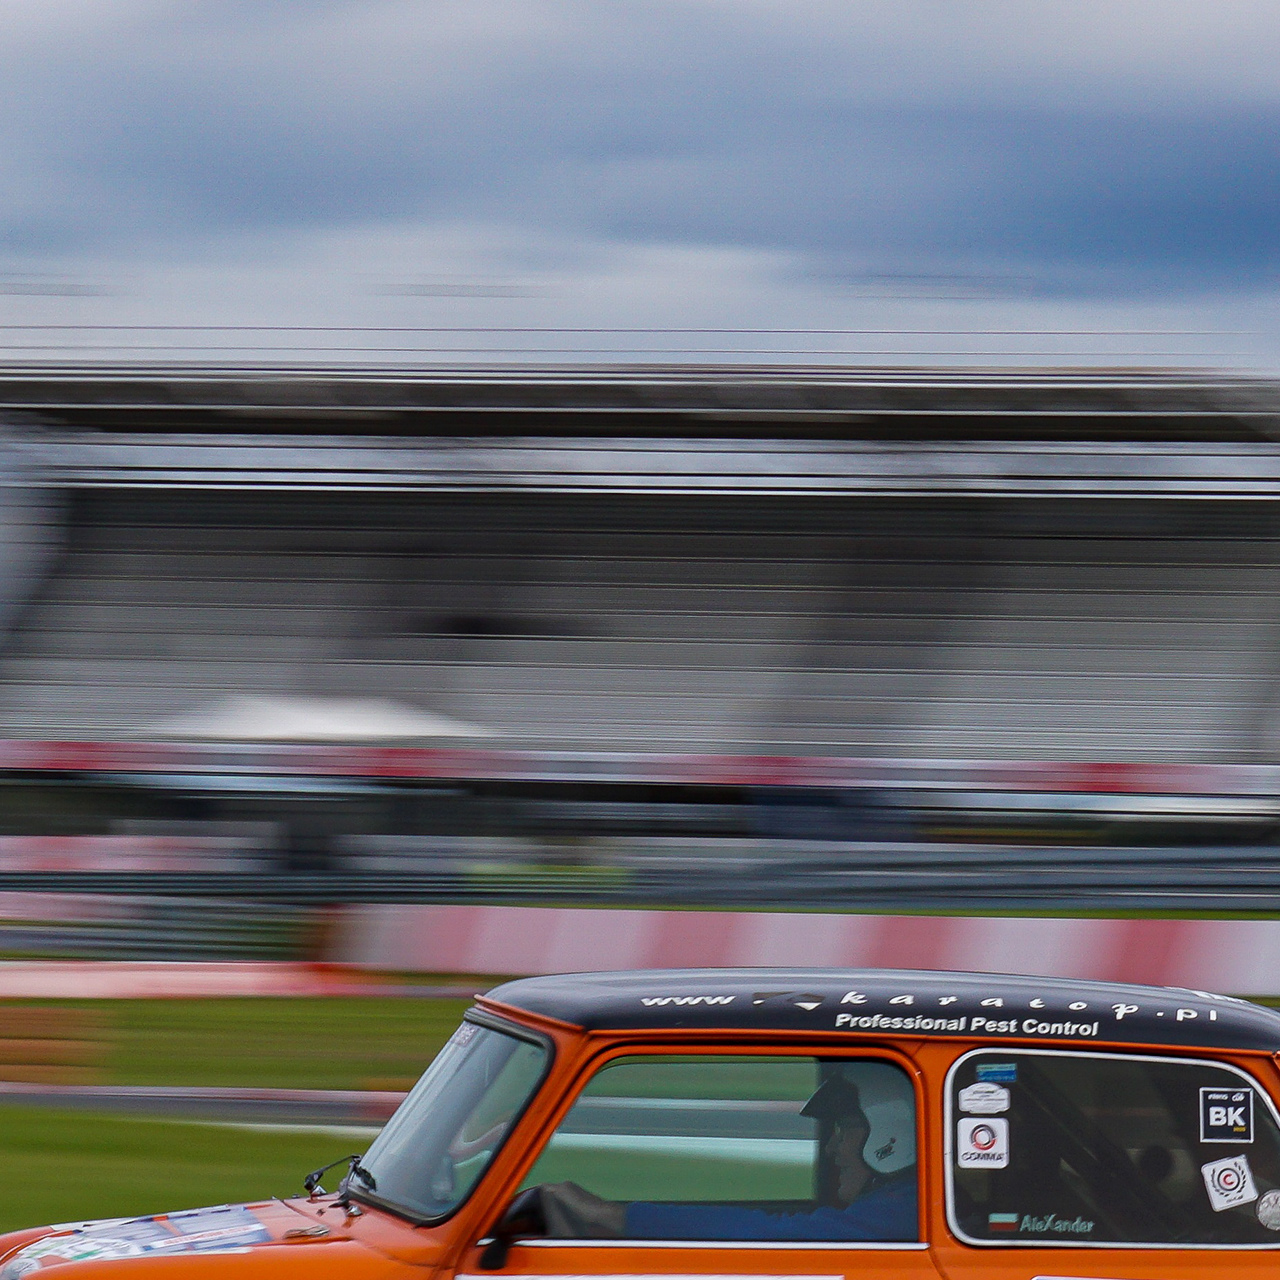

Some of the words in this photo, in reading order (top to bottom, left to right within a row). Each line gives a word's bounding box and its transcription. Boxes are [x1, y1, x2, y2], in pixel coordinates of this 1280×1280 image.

[835, 1013, 967, 1031] Professional
[970, 1017, 1018, 1033] Pest
[1022, 1019, 1099, 1036] Control
[1209, 1106, 1246, 1127] BK
[961, 1151, 1006, 1161] COMMA
